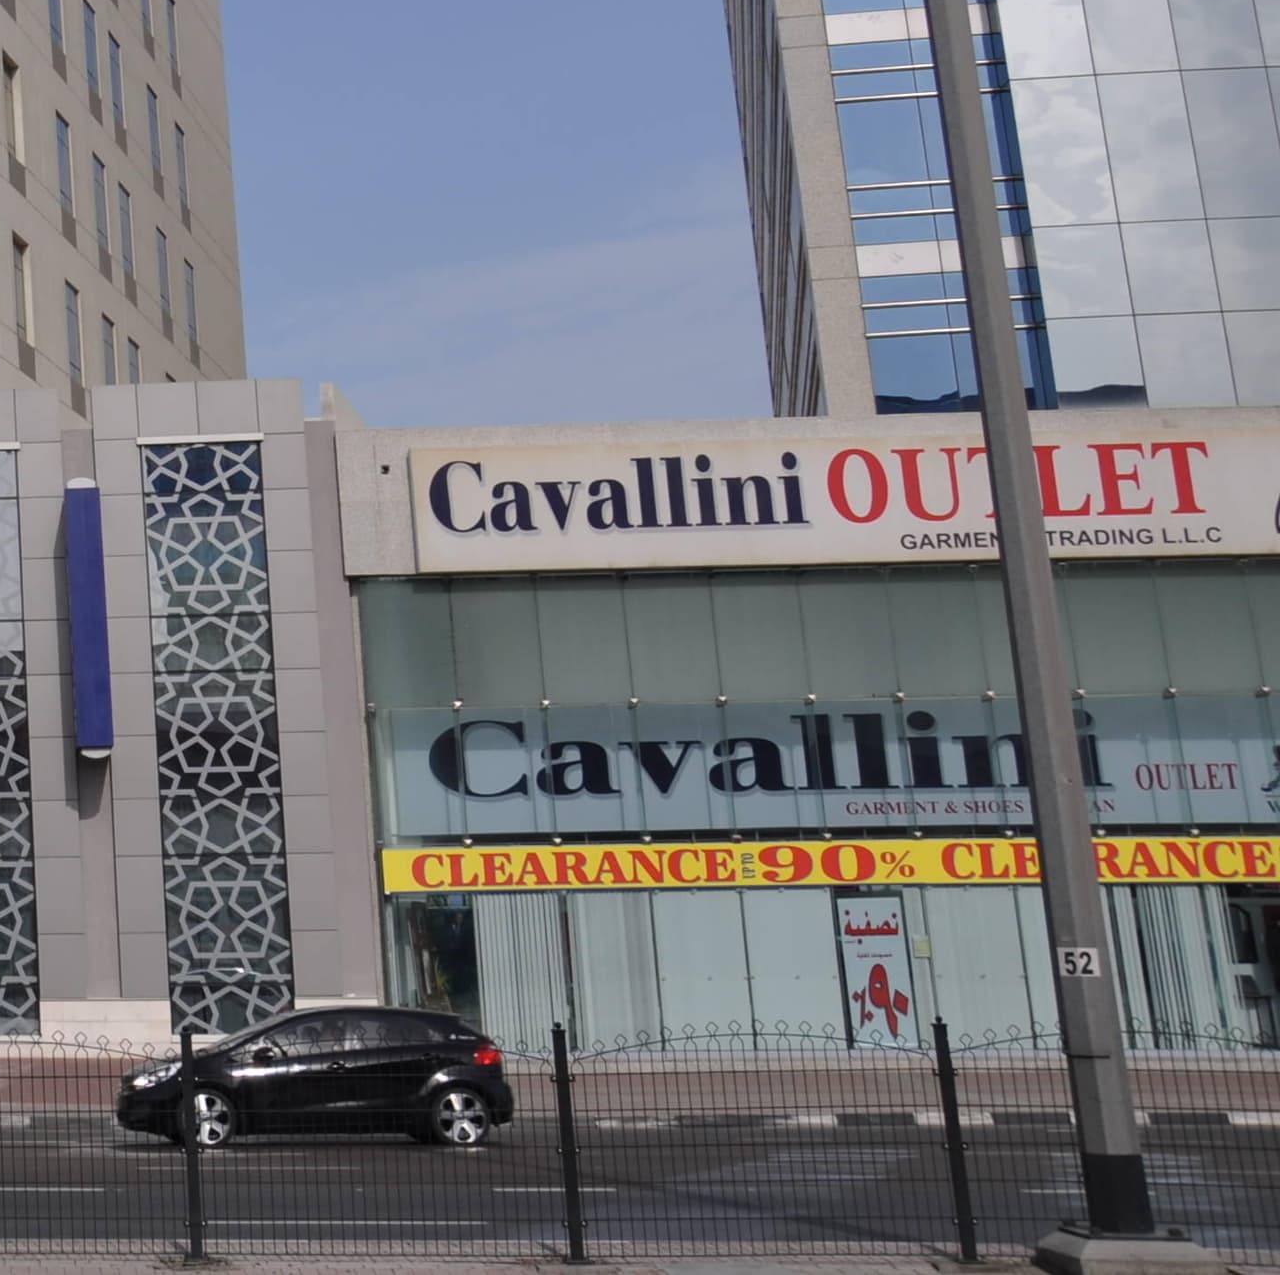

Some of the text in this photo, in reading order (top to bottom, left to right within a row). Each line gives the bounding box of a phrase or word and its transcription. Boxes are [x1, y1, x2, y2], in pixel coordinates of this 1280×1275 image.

[429, 452, 810, 533] Cavallini
[1045, 527, 1153, 547] TRADING
[1162, 527, 1222, 545] L.L.C
[429, 710, 1238, 797] Cavallini OUTLET
[846, 800, 939, 815] GARMENT
[944, 802, 958, 814] &
[964, 800, 1025, 814] SHOES
[411, 848, 736, 888] CLEARANCE
[758, 844, 915, 883] 90%
[941, 840, 1277, 880] CLERANCE
[1064, 951, 1094, 975] 52
